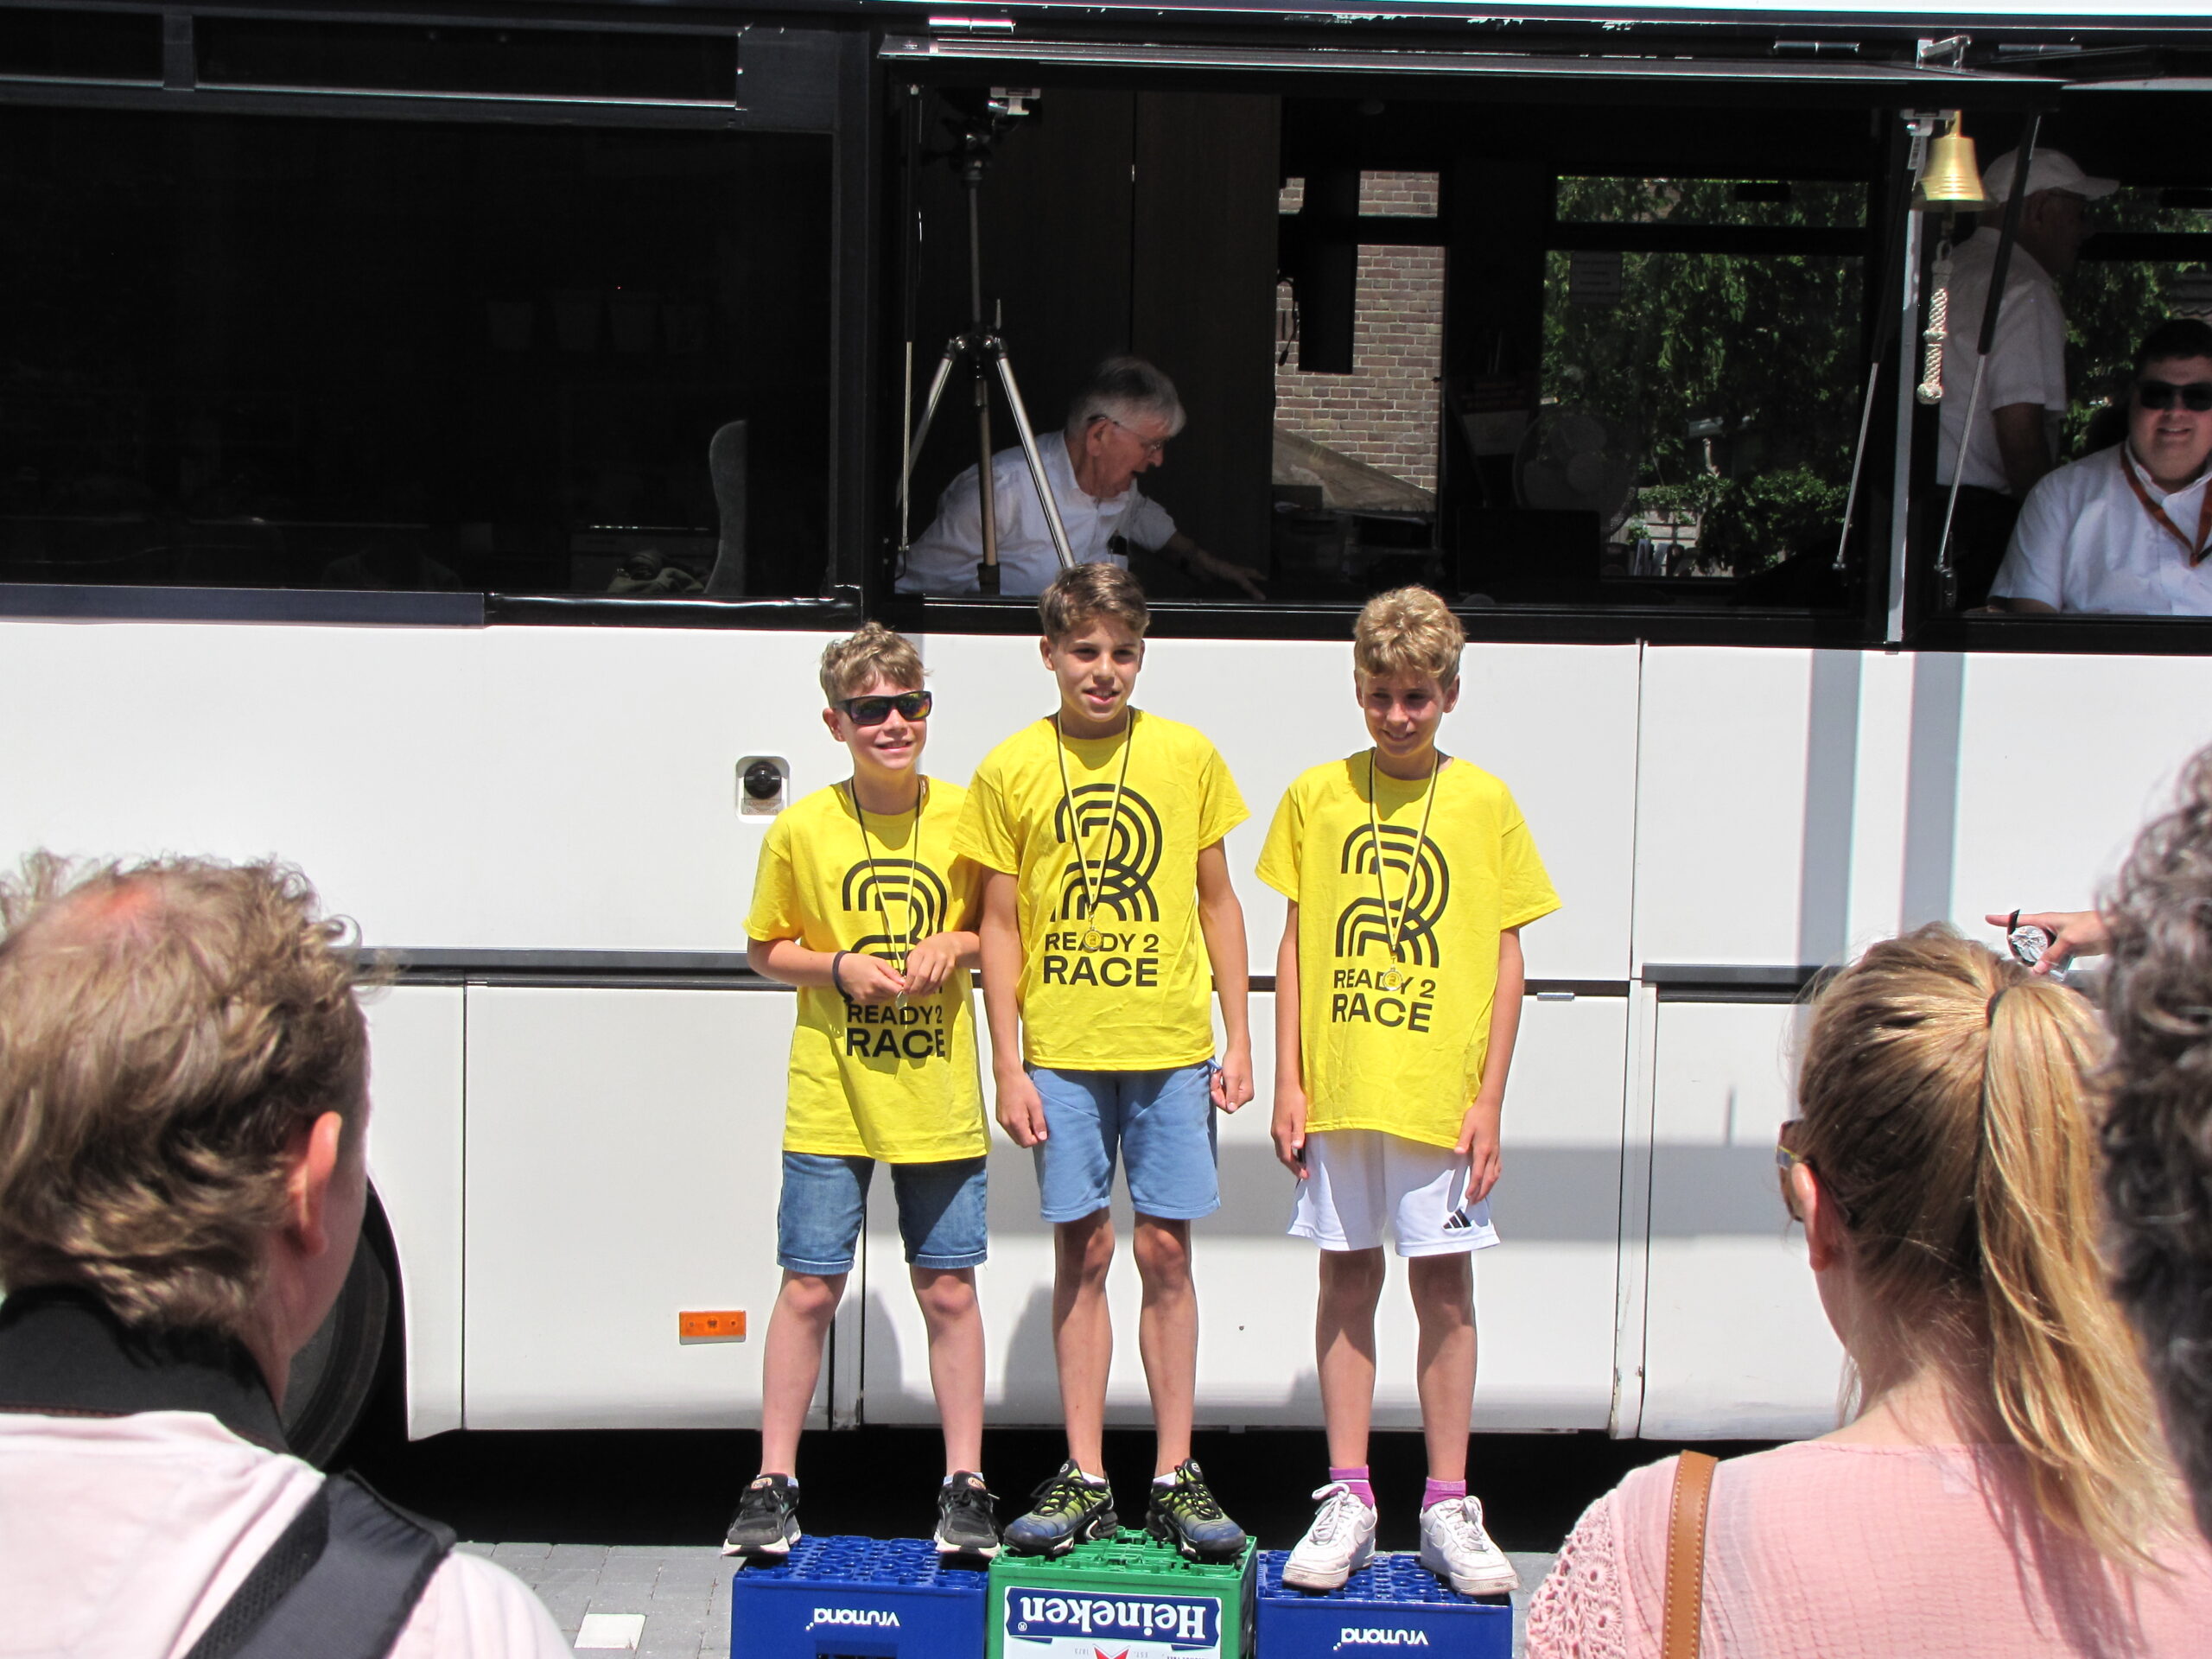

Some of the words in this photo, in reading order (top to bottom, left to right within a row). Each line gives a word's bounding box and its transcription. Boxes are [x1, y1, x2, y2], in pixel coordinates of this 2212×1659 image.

[1143, 933, 1160, 953] 2
[1043, 955, 1159, 988] RACE
[1419, 978, 1437, 999] 2
[847, 1003, 934, 1026] READY
[935, 1004, 943, 1024] 2
[1332, 992, 1433, 1033] RACE
[846, 1027, 946, 1059] RACE
[814, 1607, 900, 1627] vrumona
[1020, 1597, 1207, 1639] Heineken
[1340, 1627, 1429, 1645] vrumona
